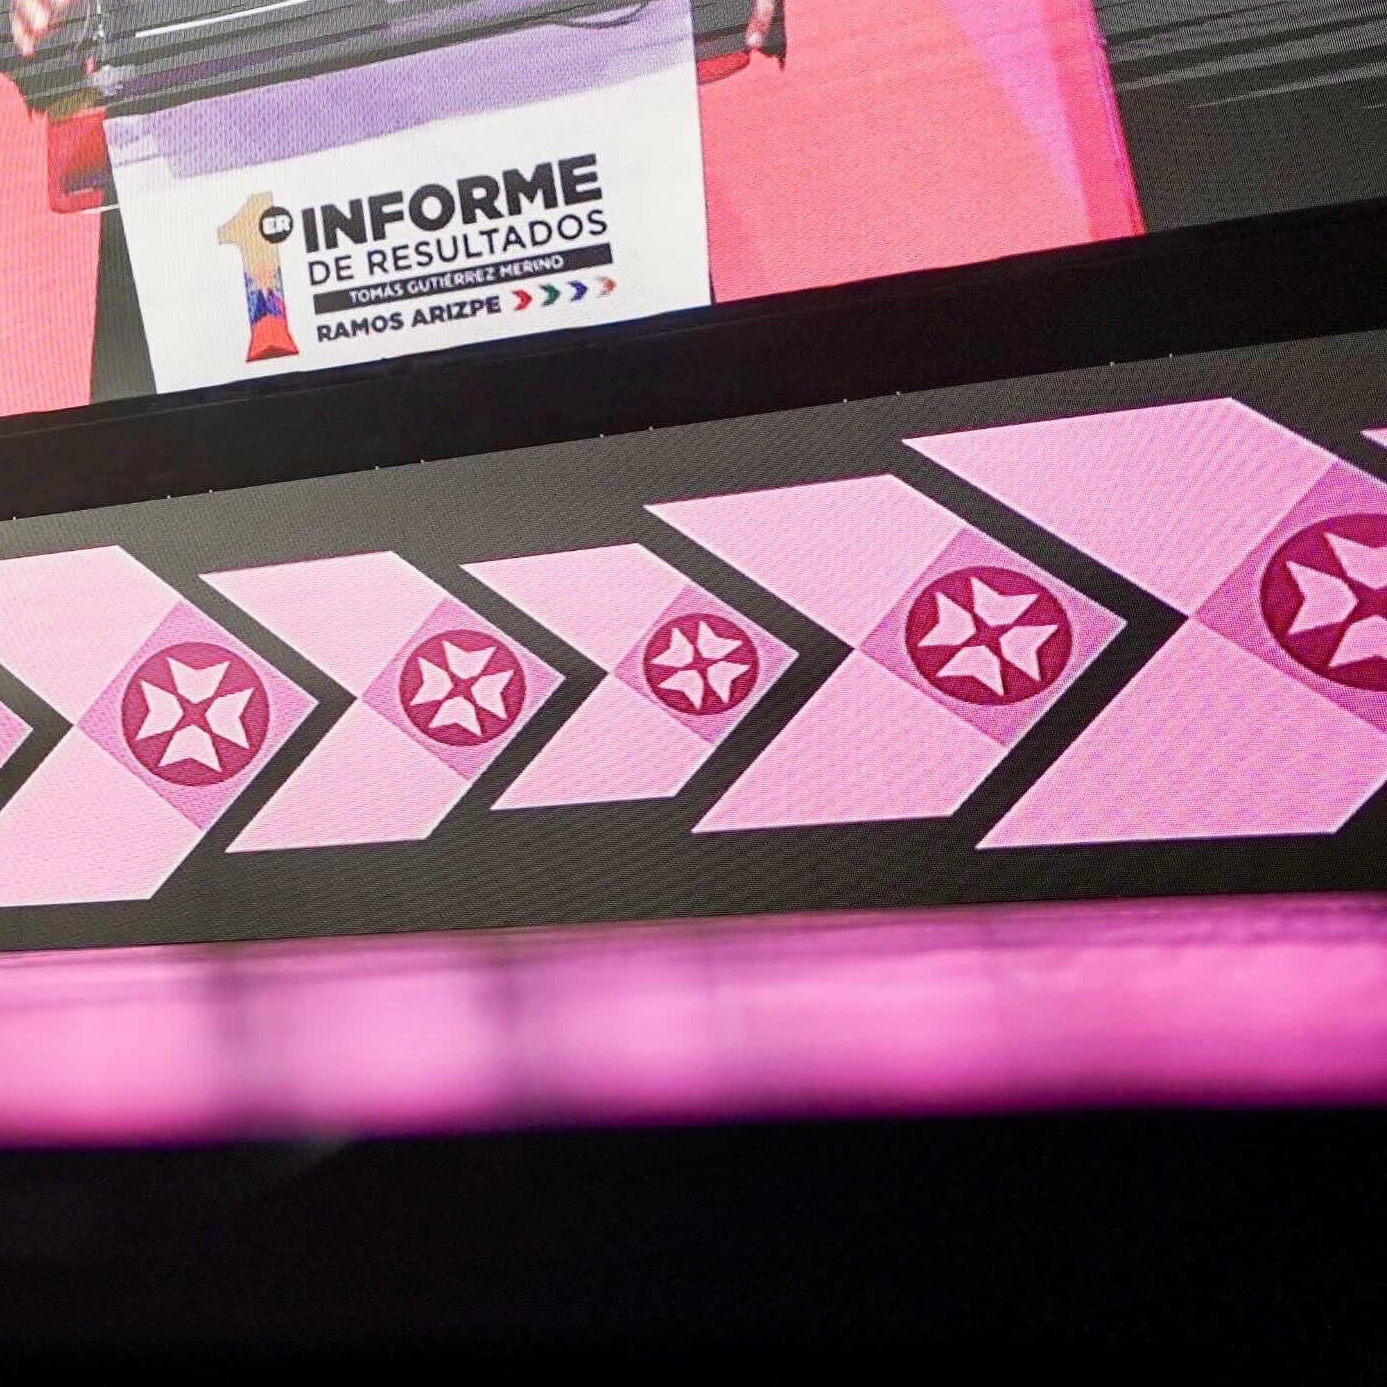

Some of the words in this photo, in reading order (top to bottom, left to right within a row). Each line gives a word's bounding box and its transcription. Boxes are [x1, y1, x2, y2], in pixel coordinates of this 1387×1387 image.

[301, 153, 603, 254] INFORME
[308, 255, 354, 286] DE
[366, 209, 608, 276] RESULTADOS
[316, 311, 404, 343] RAMOS
[411, 295, 502, 328] ARIZPE
